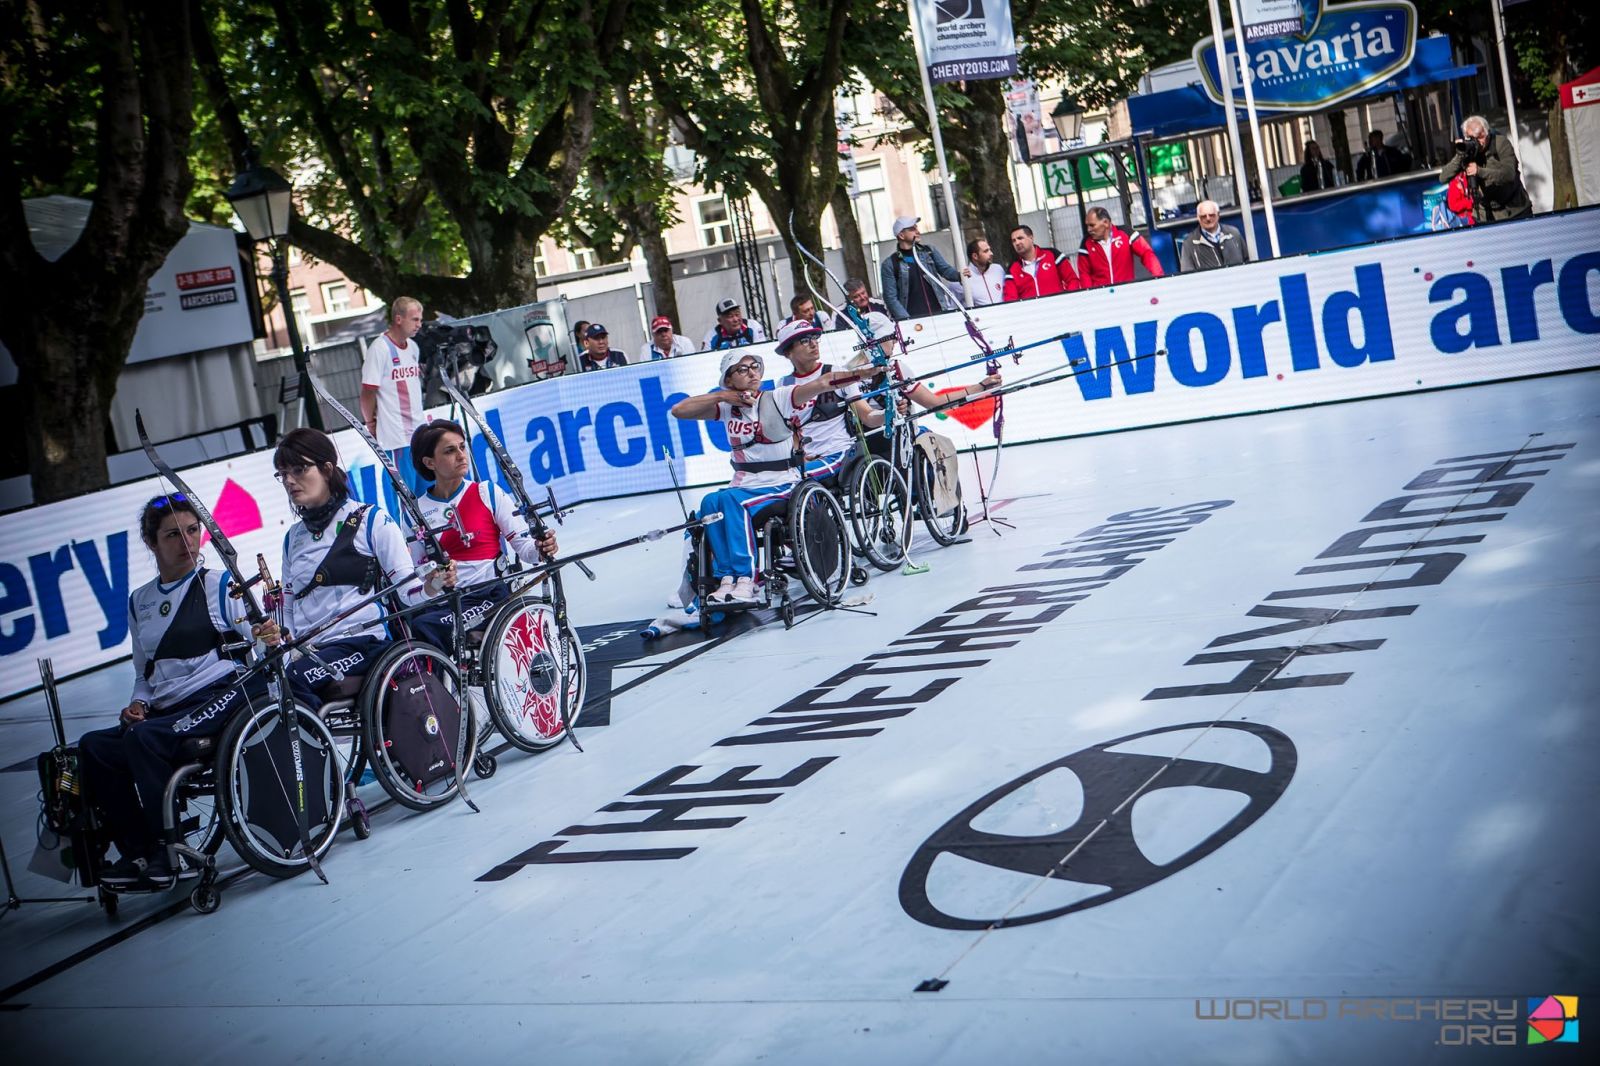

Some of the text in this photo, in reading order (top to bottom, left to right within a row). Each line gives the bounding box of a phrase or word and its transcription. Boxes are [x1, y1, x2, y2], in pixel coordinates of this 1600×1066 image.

[1226, 22, 1394, 89] Bavaria
[1061, 262, 1397, 402] world
[1142, 442, 1577, 701] HYUNDAI
[474, 499, 1236, 882] THE NETHERLANDS
[291, 740, 303, 782] WIAWIS
